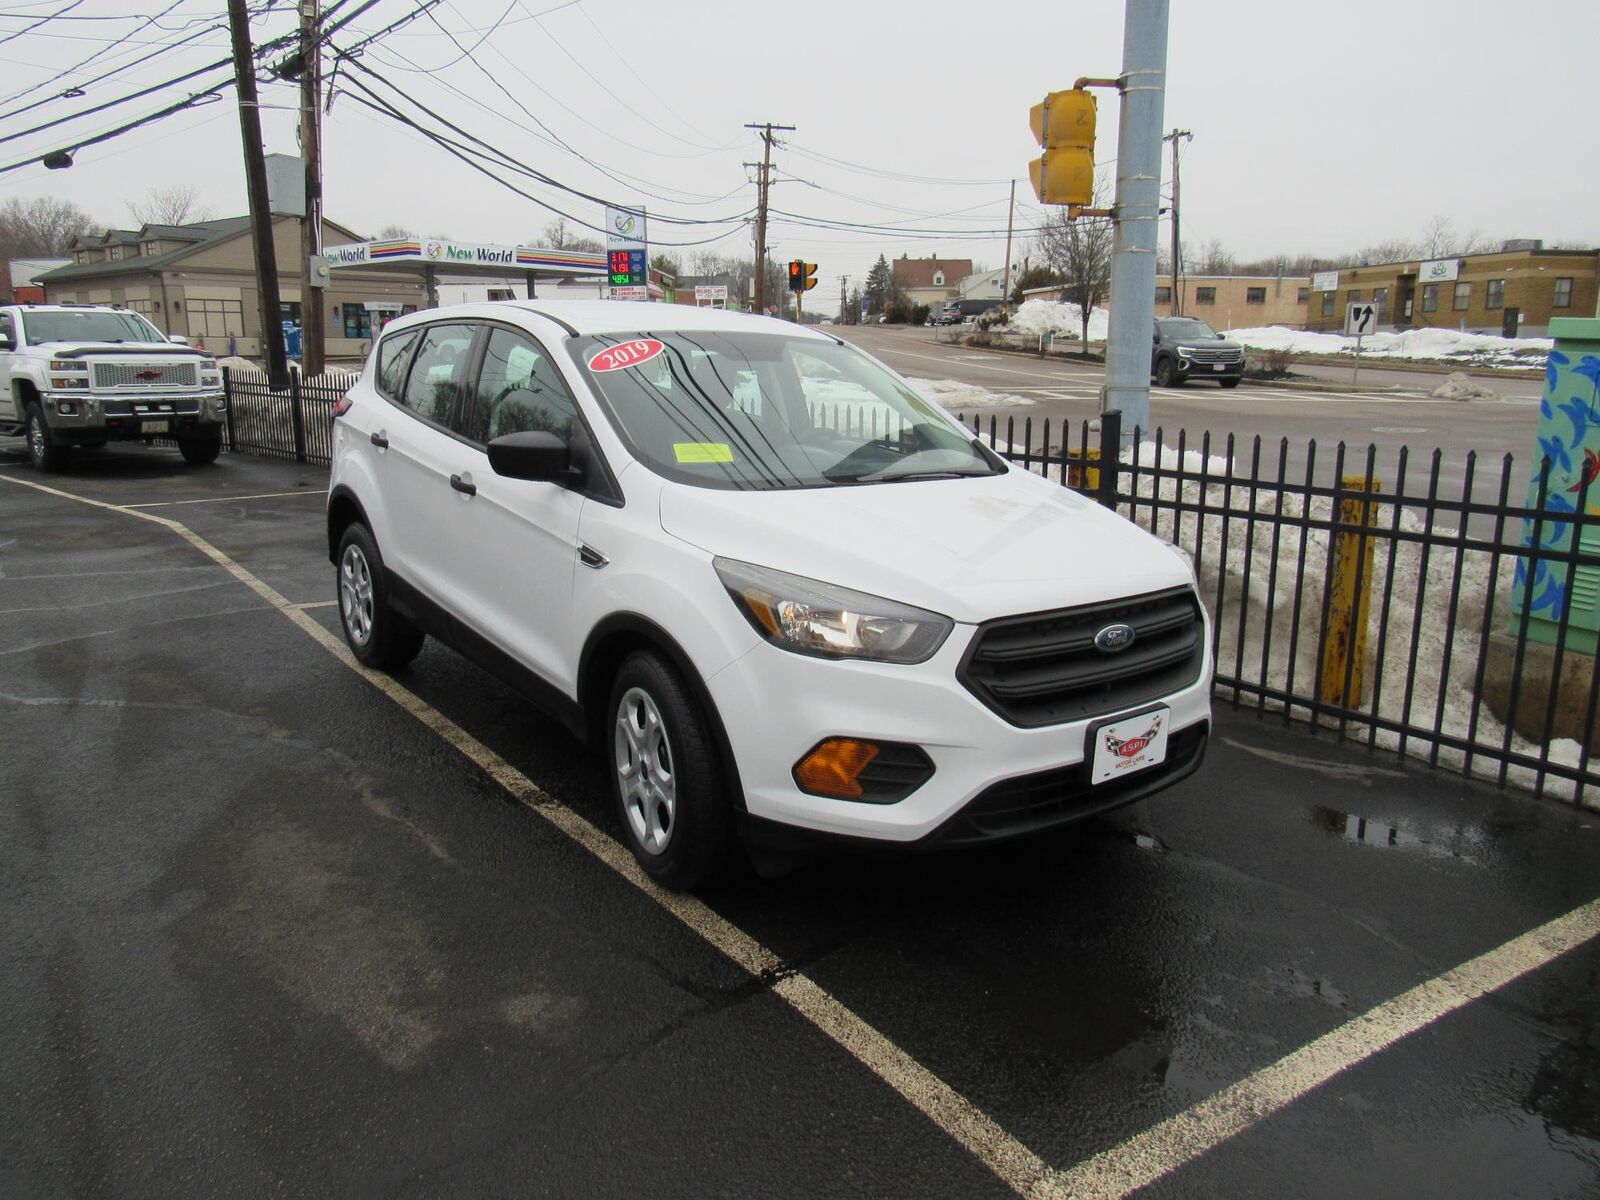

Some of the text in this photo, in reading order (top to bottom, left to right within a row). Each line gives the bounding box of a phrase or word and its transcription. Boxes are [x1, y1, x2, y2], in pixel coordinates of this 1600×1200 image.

[340, 247, 365, 261] World
[447, 245, 513, 262] New World
[602, 341, 650, 369] 2019
[1107, 630, 1128, 646] Ford
